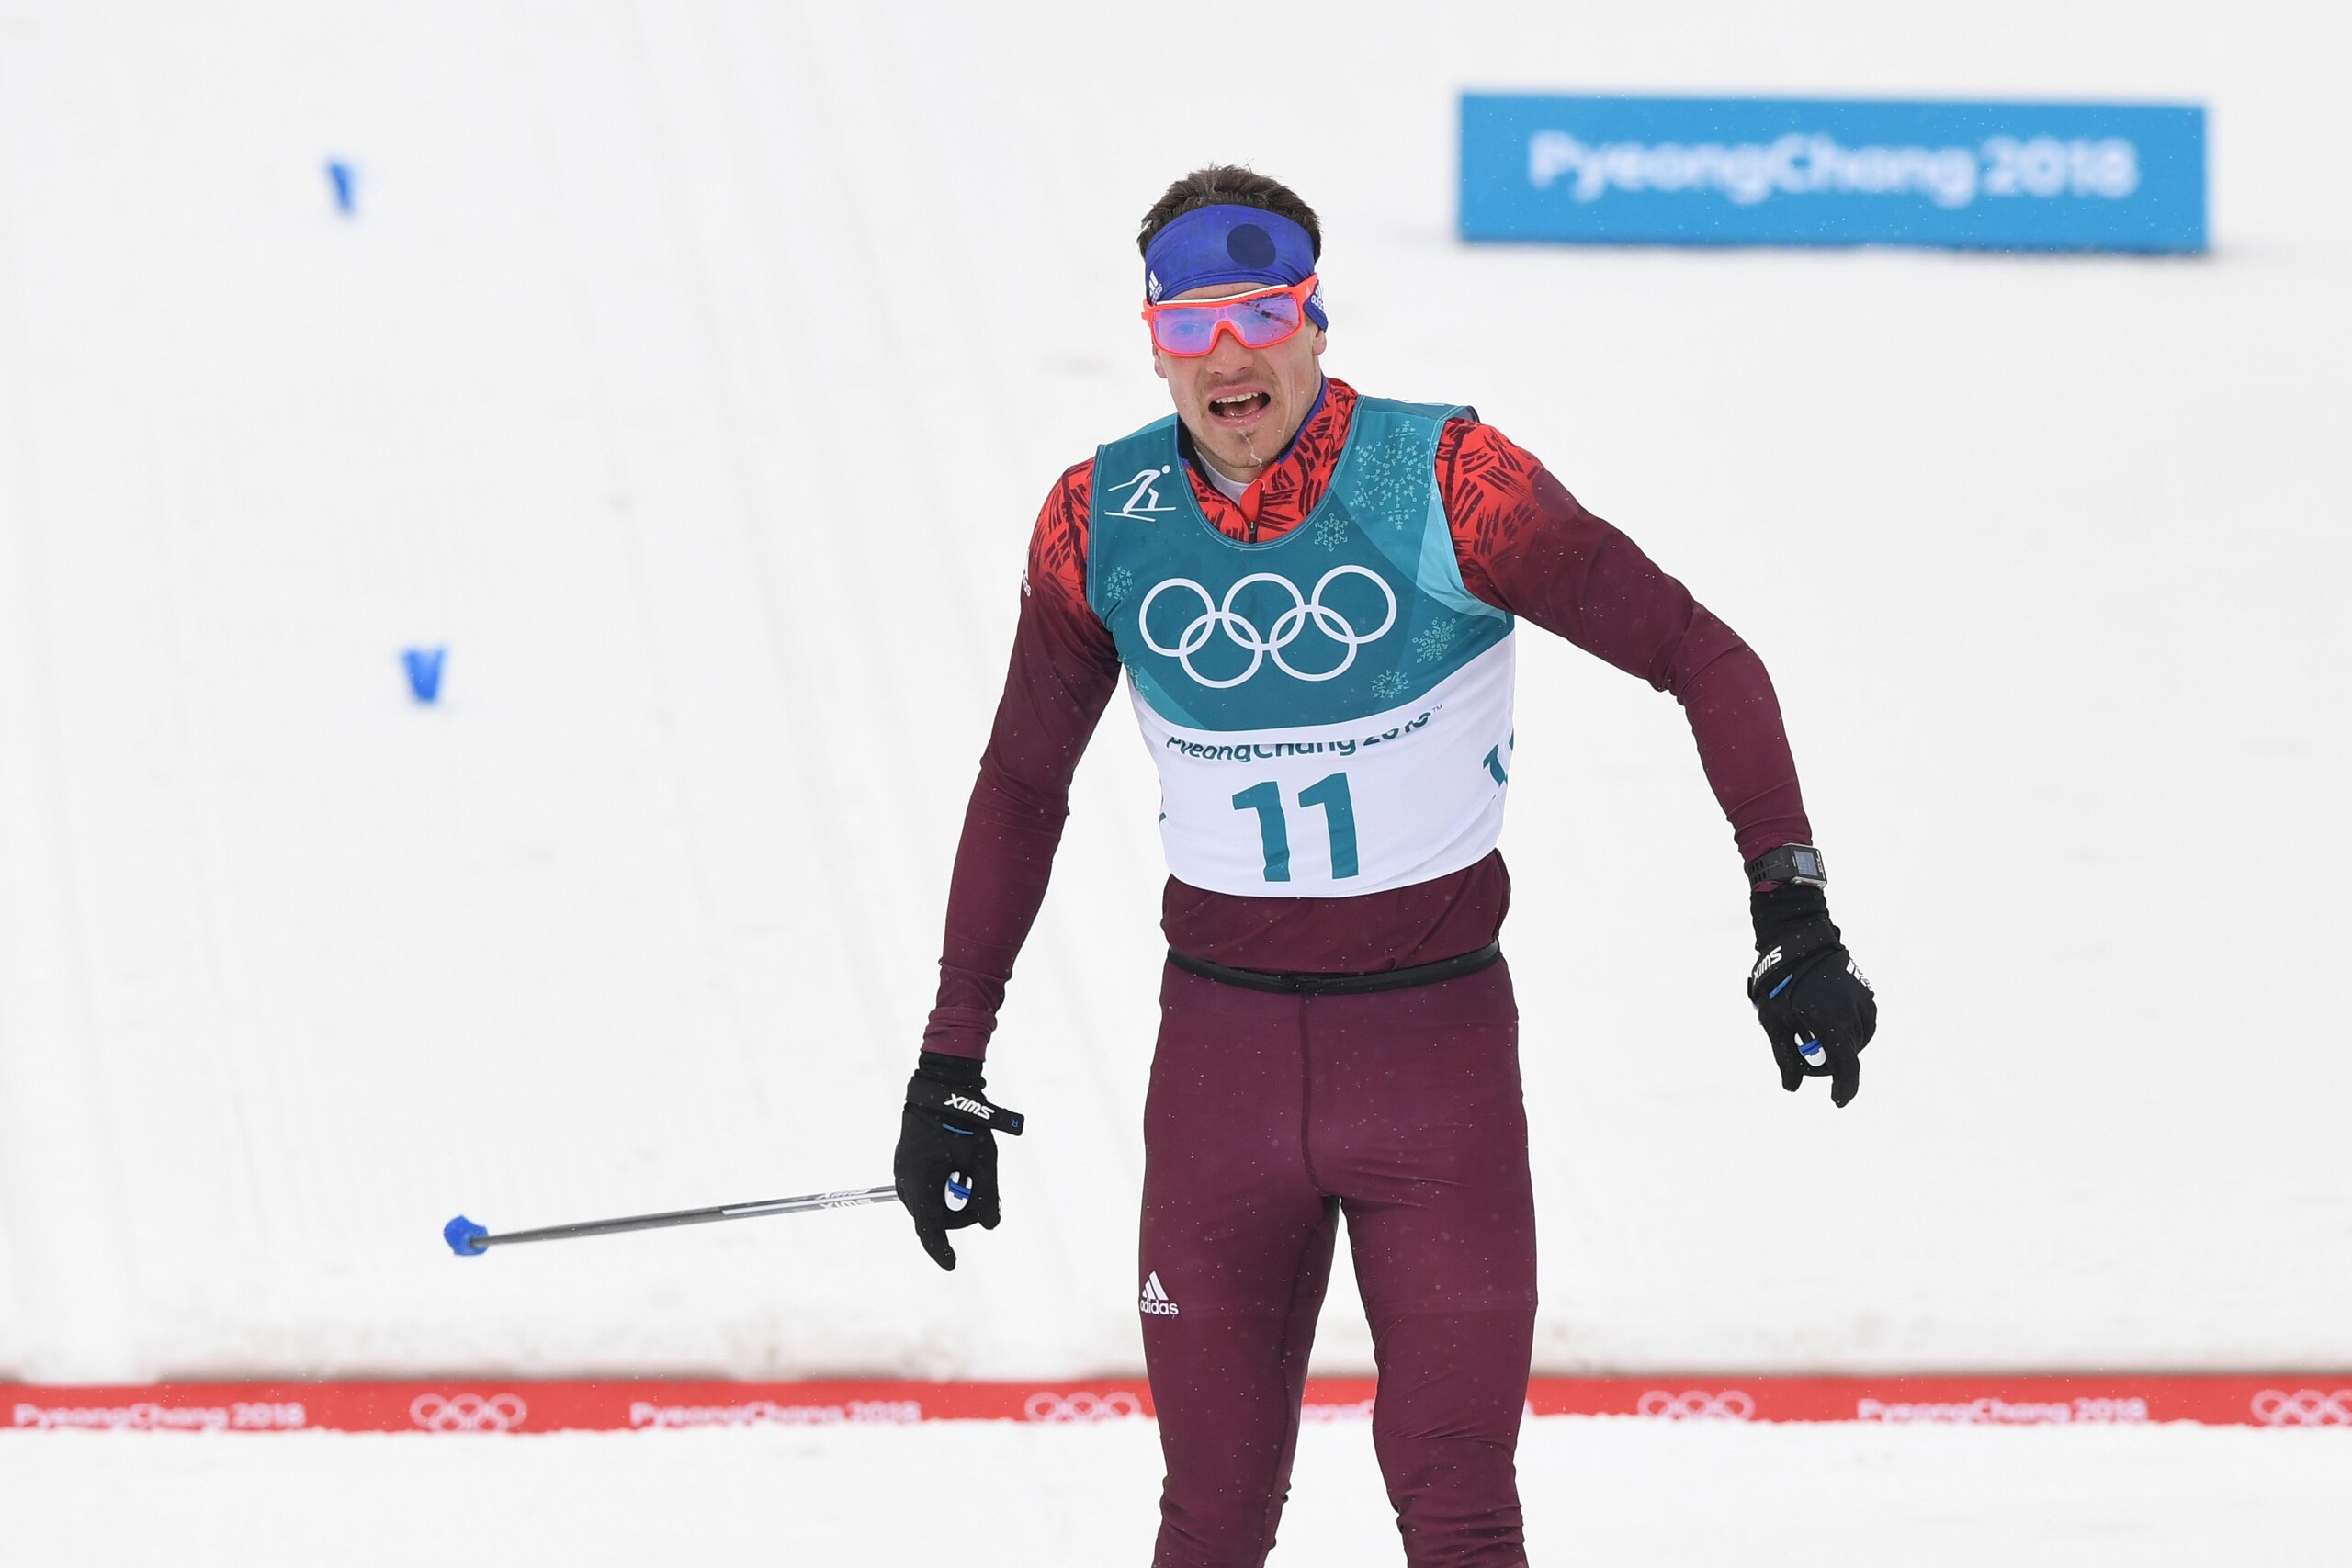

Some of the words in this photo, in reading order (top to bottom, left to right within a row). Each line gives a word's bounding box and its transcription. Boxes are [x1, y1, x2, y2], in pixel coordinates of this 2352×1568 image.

[1529, 129, 1977, 208] PyeongChang
[1979, 135, 2140, 198] 2018
[1231, 771, 1360, 883] 11
[944, 1093, 995, 1120] SWIX
[1140, 1297, 1180, 1315] adidas
[14, 1402, 227, 1430] PyeongChang
[230, 1401, 306, 1429] 2018
[844, 1400, 921, 1425] 2018
[1857, 1398, 2071, 1423] PyeongChang
[2072, 1397, 2148, 1423] 2018
